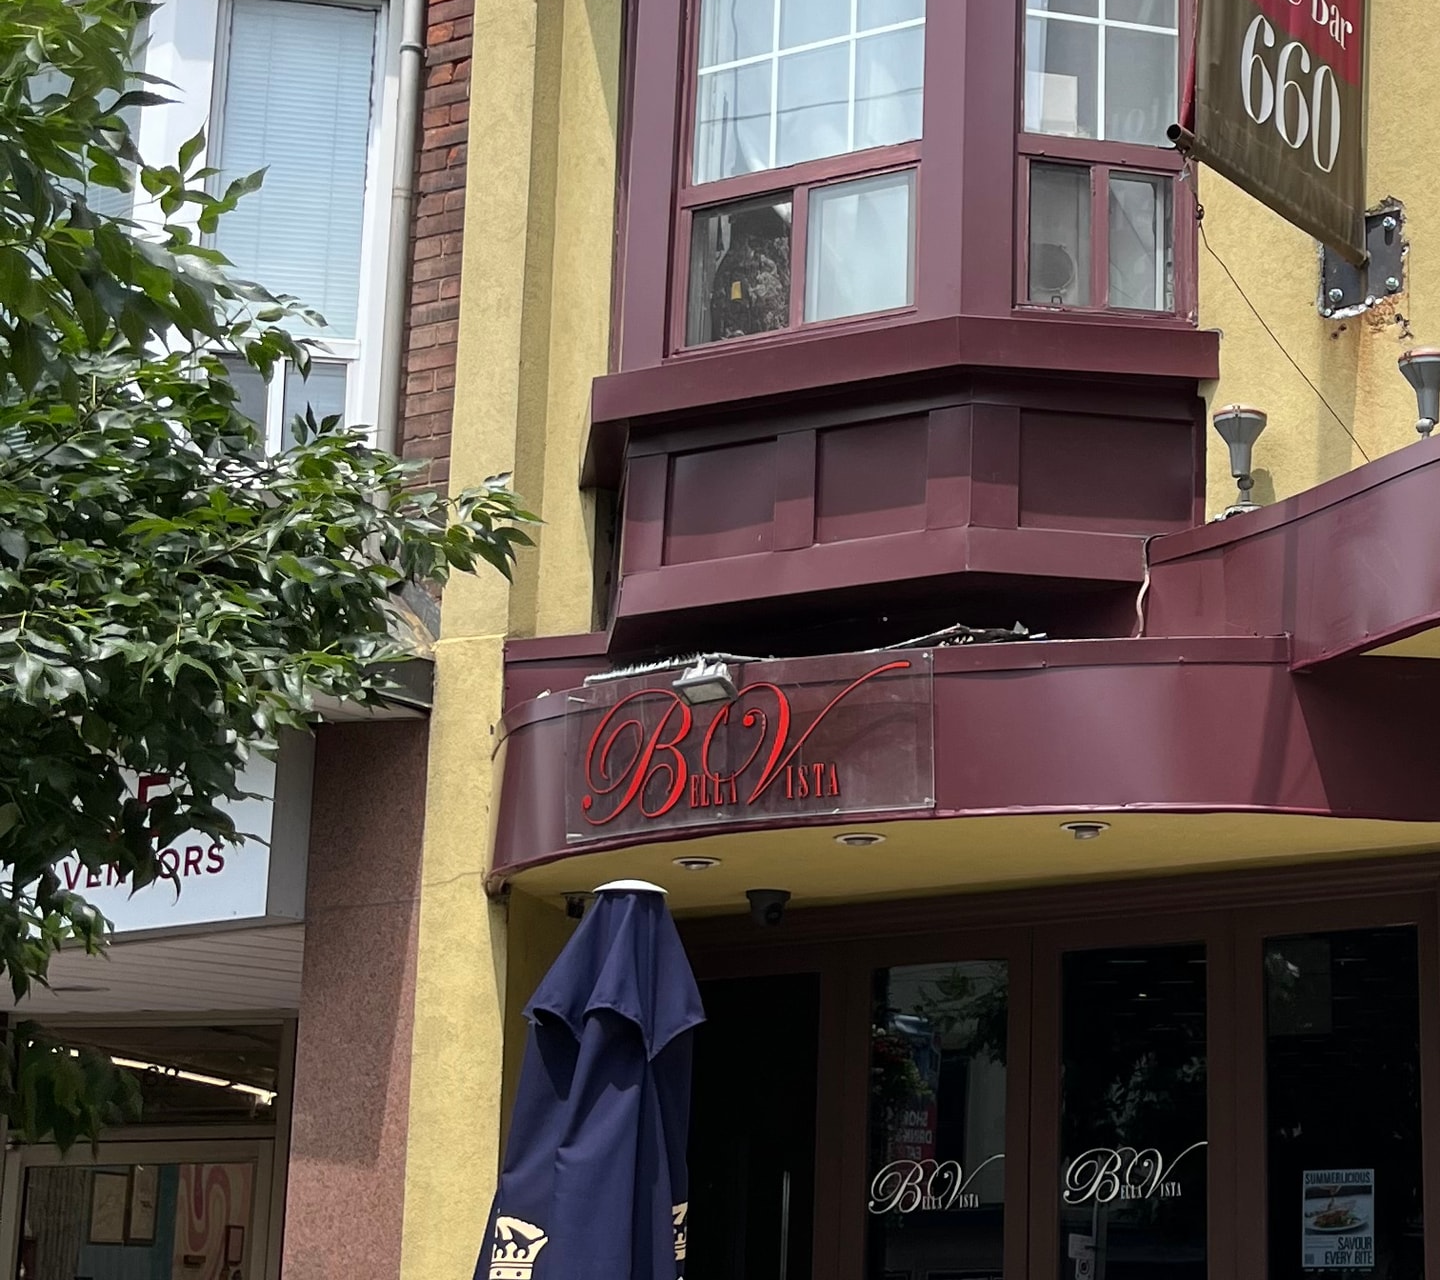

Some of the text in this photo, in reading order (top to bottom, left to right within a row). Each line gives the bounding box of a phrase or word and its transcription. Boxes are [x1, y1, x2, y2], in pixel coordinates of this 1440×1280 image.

[1240, 13, 1341, 173] 660
[64, 843, 225, 891] VENORS
[1305, 1172, 1371, 1185] SUMMERLICIOUS
[1338, 1236, 1372, 1250] SAVOUR
[1325, 1251, 1373, 1265] EVERY BITE
